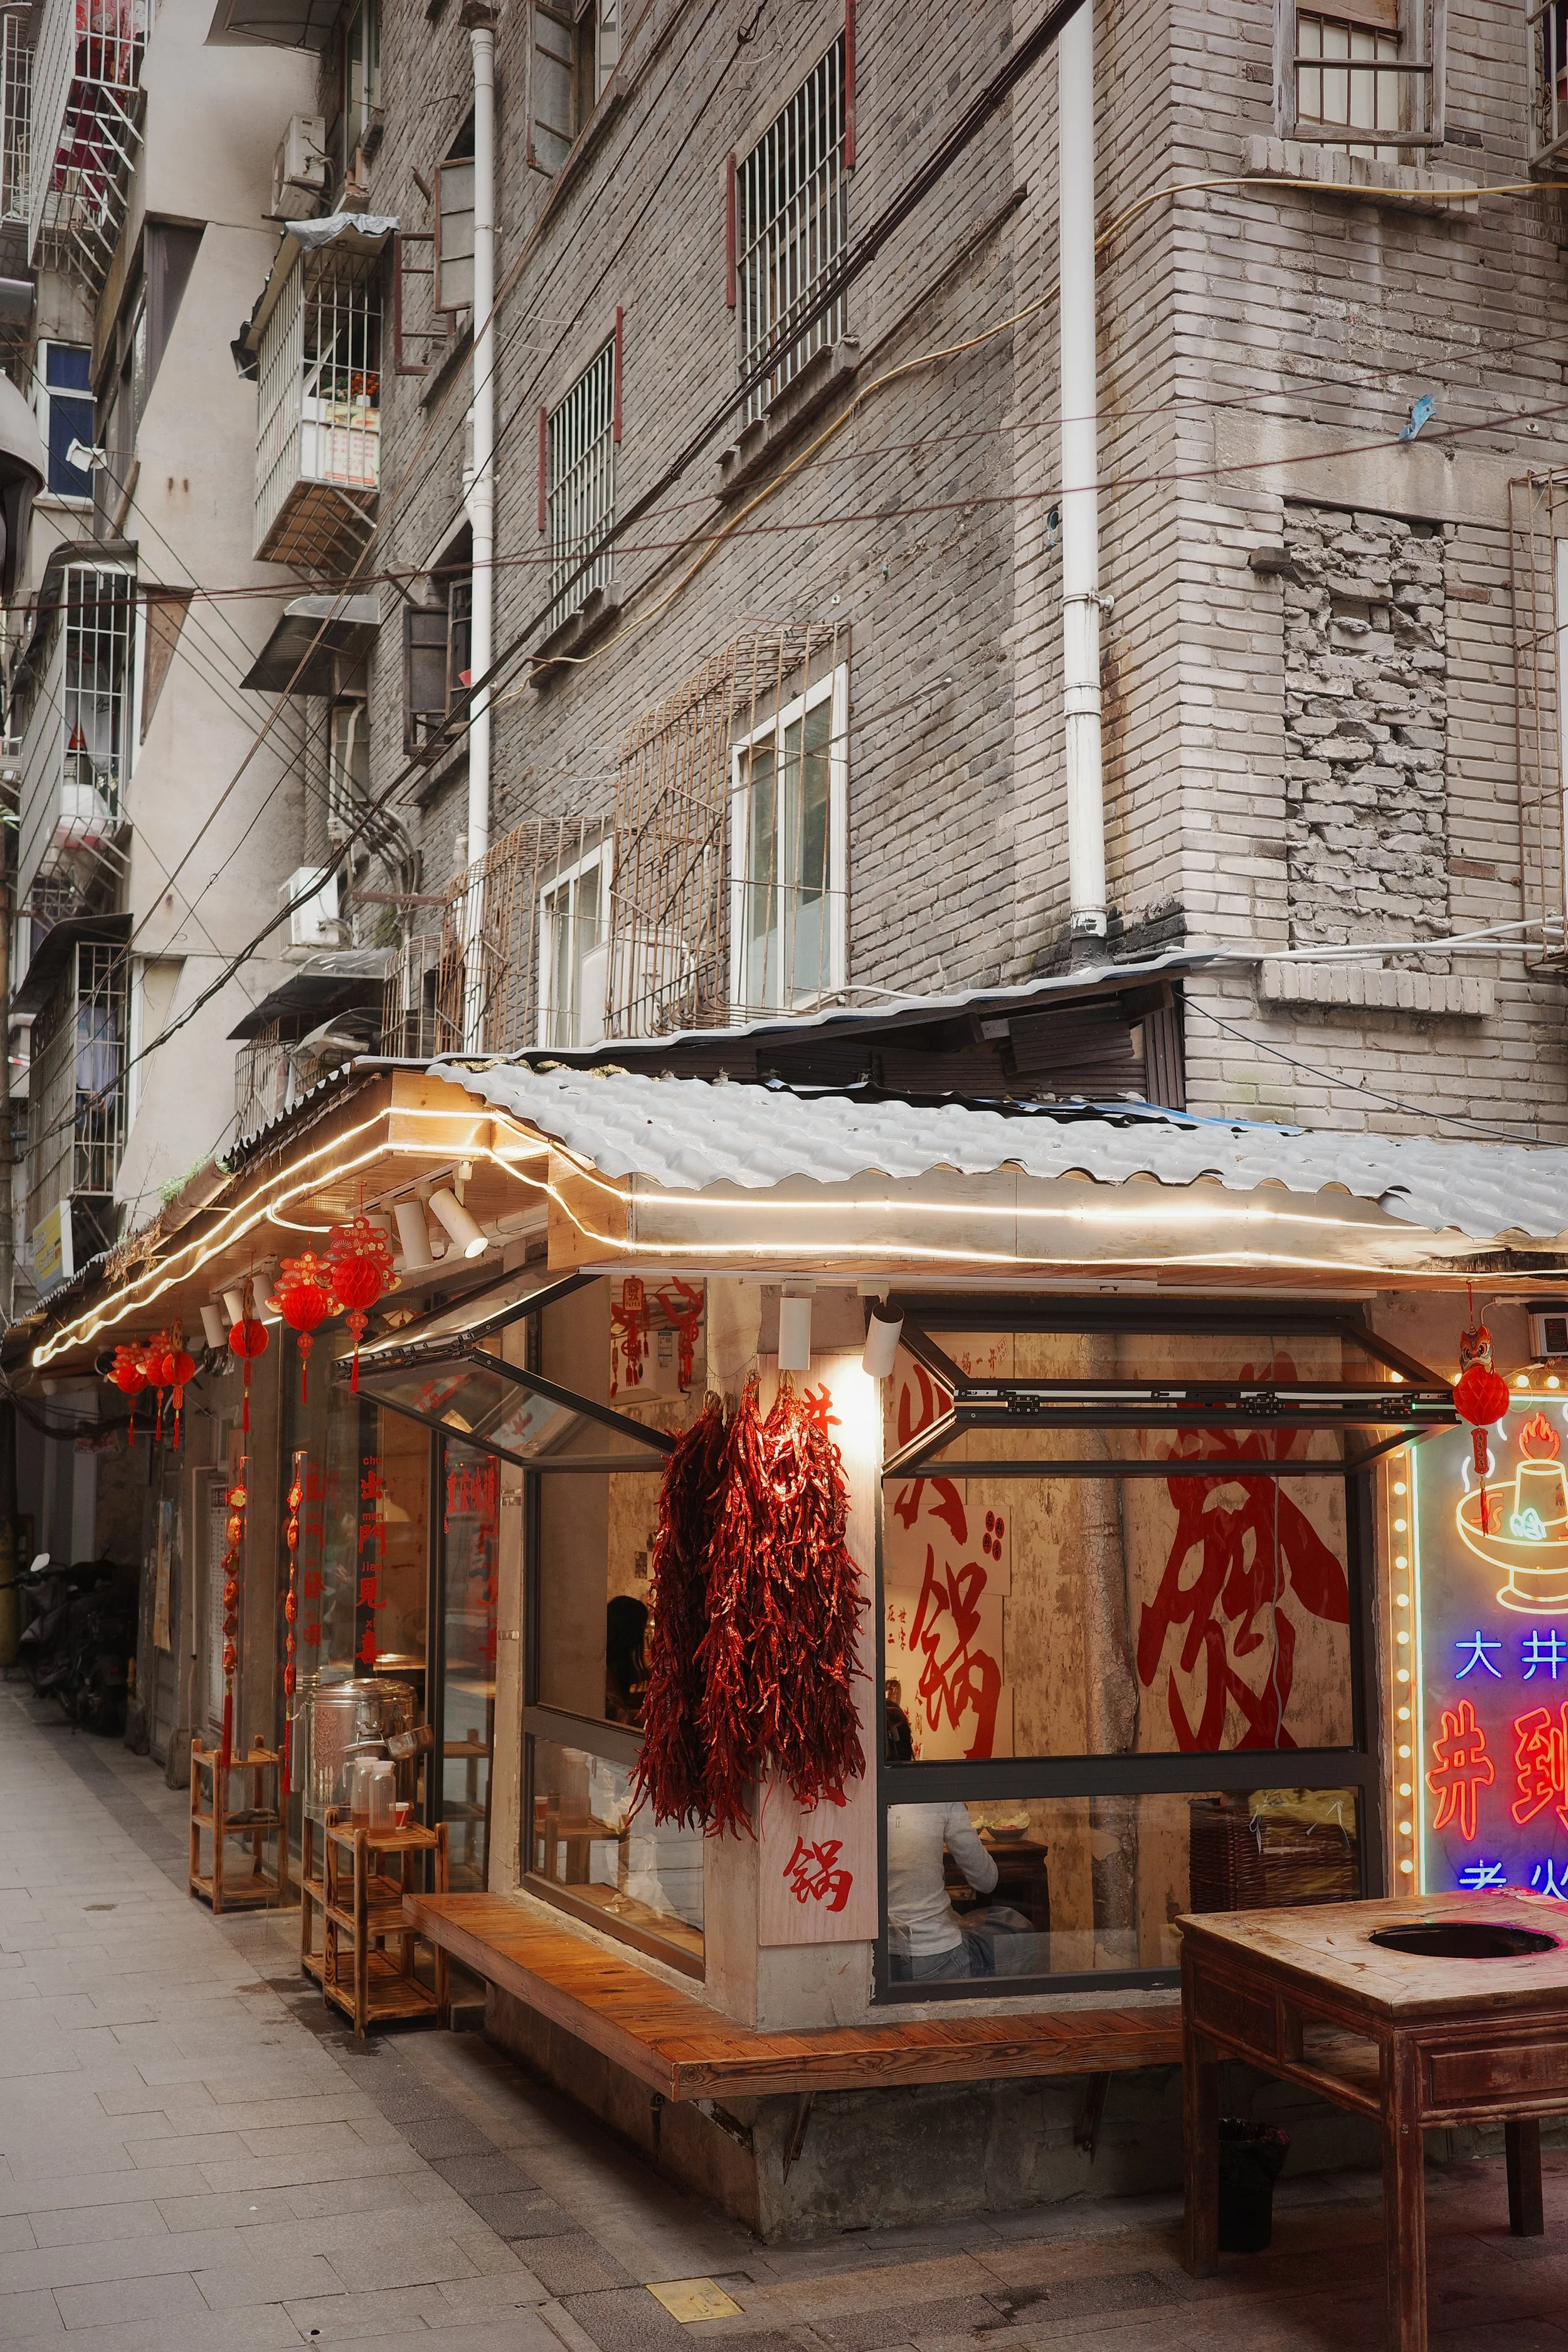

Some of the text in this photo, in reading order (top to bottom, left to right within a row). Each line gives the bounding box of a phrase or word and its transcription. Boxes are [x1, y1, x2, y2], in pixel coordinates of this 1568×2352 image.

[363, 1455, 382, 1466] chu
[361, 1470, 383, 1500] 出
[363, 1513, 383, 1521] men
[358, 1523, 386, 1555] 門
[356, 1577, 387, 1609] 見
[366, 1618, 376, 1628] xi
[1454, 1629, 1567, 1680] 大井
